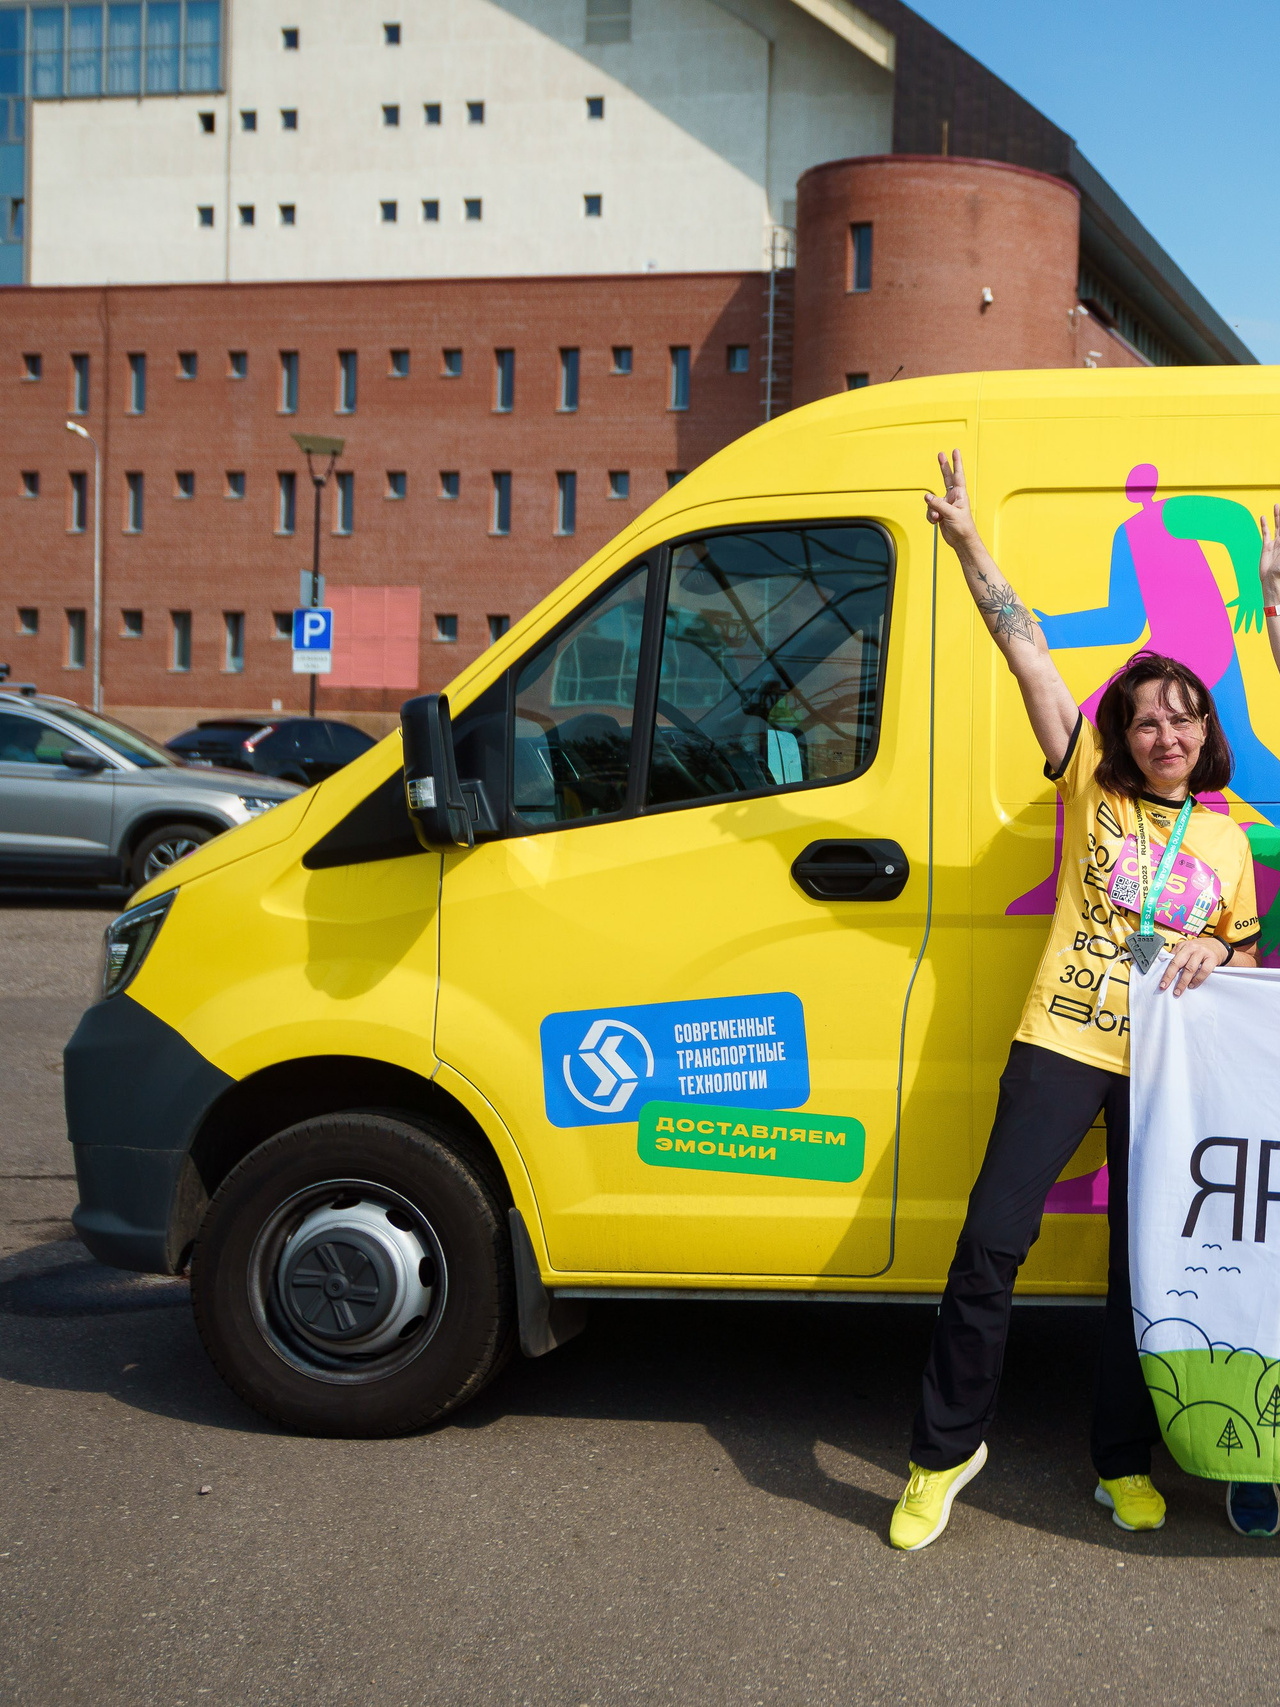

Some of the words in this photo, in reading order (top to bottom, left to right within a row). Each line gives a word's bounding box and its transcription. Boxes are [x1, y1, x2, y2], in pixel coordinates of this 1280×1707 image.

[1138, 823, 1147, 856] RUSSIAN
[674, 1016, 776, 1044] СОВРЕМЕННЫЕ
[676, 1041, 786, 1070] ТРАНСПОРТНЫЕ
[678, 1070, 768, 1096] ТЕХНОЛОГИИ
[655, 1116, 847, 1146] ДОСТАВЛЯЕМ
[655, 1137, 777, 1160] ЭМОЦИИ
